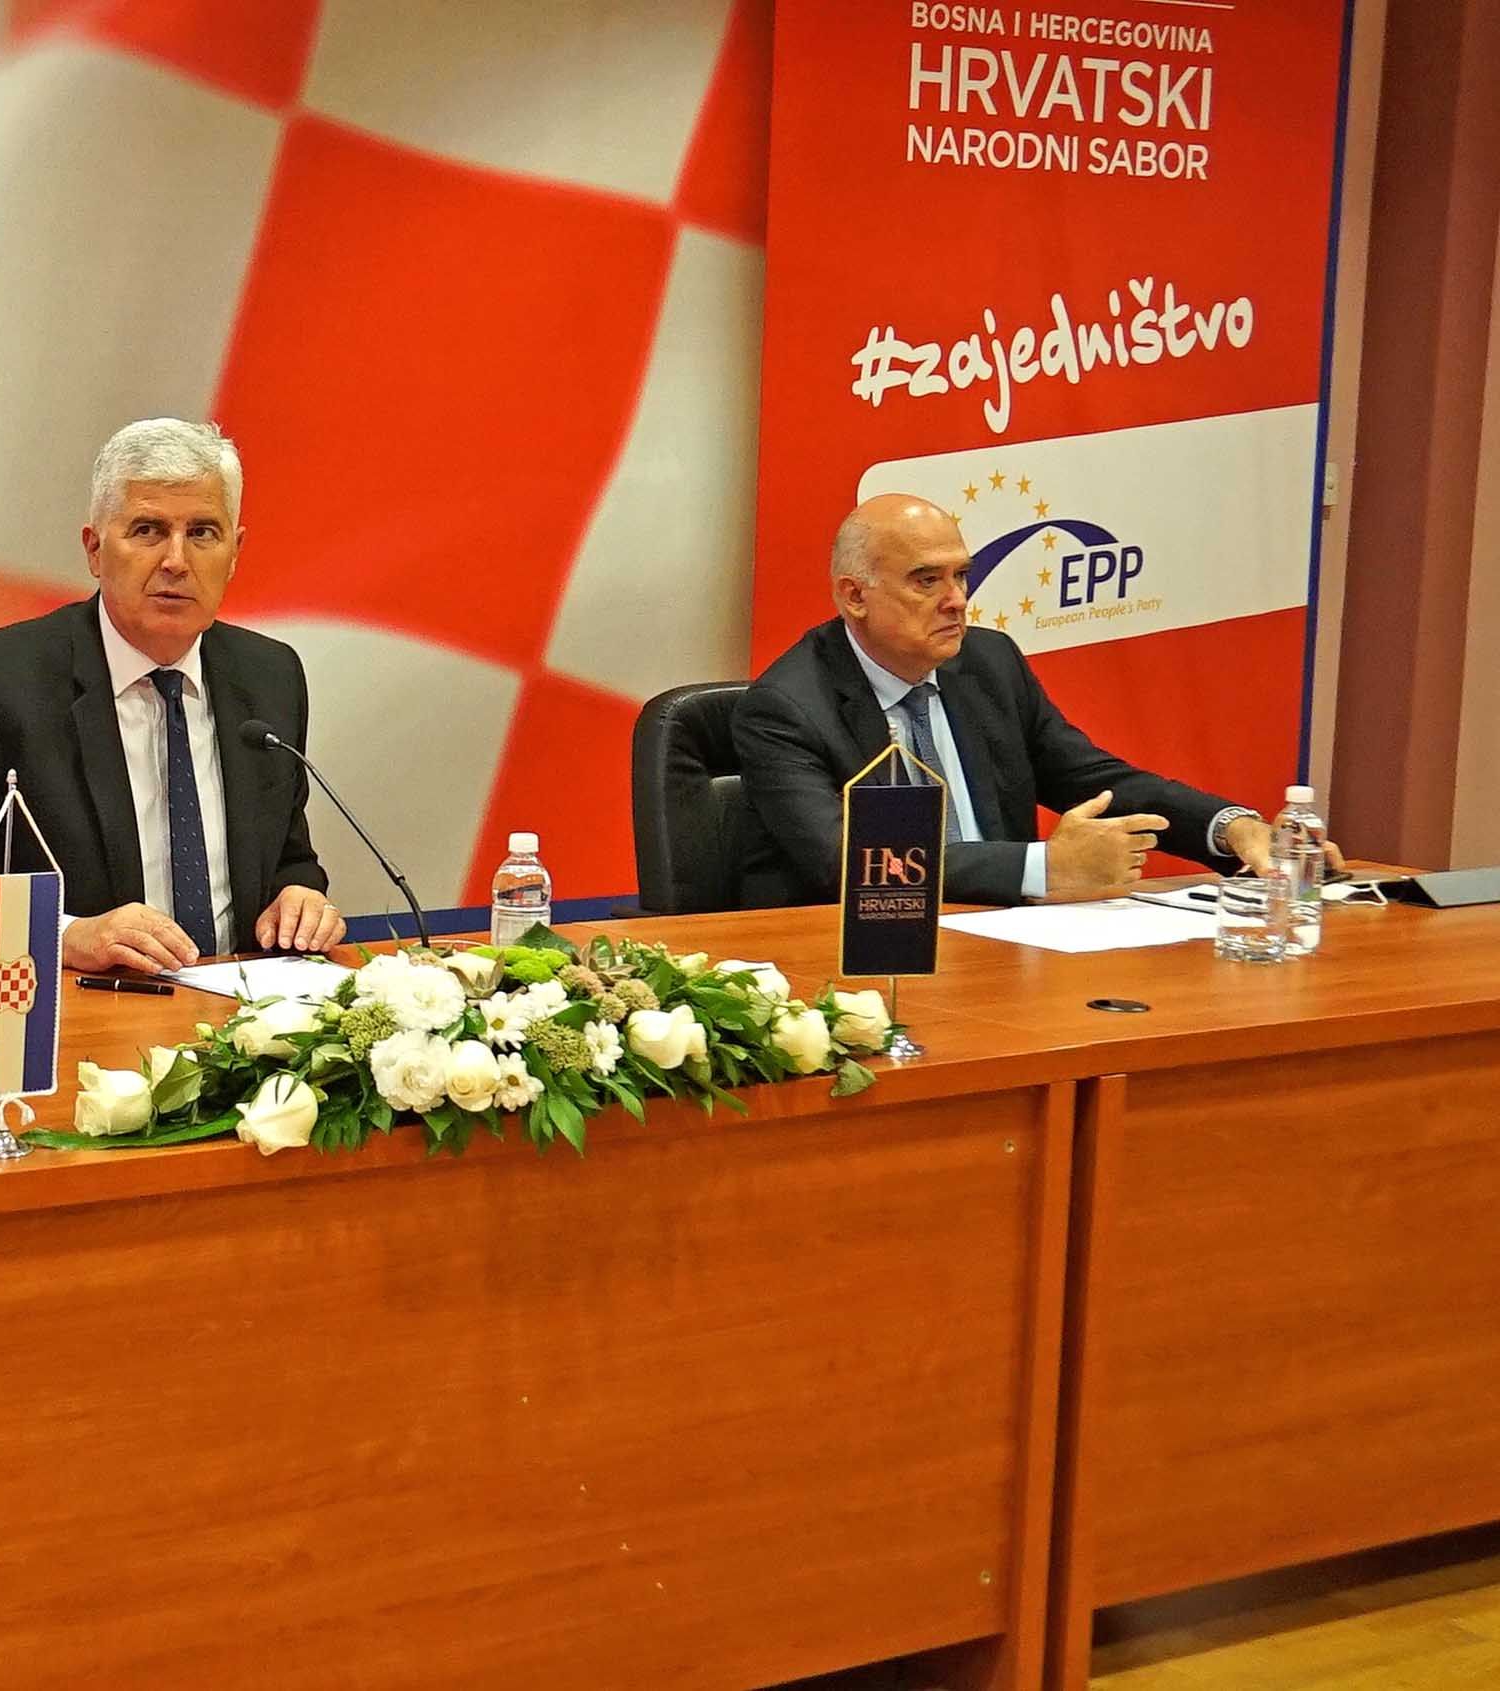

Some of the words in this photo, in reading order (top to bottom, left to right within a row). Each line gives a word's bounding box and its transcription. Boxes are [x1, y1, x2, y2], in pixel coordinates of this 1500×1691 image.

[911, 1, 1005, 35] BOSNA
[1014, 11, 1021, 37] I
[1030, 14, 1214, 53] HERCEGOVINA
[908, 42, 1213, 130] HRVATSKI
[907, 124, 1079, 172] NARODNI
[1088, 137, 1209, 181] SABOR
[851, 276, 1253, 434] #zajedništvo
[1060, 546, 1143, 608] EPP
[859, 897, 926, 912] HRVATSKI
